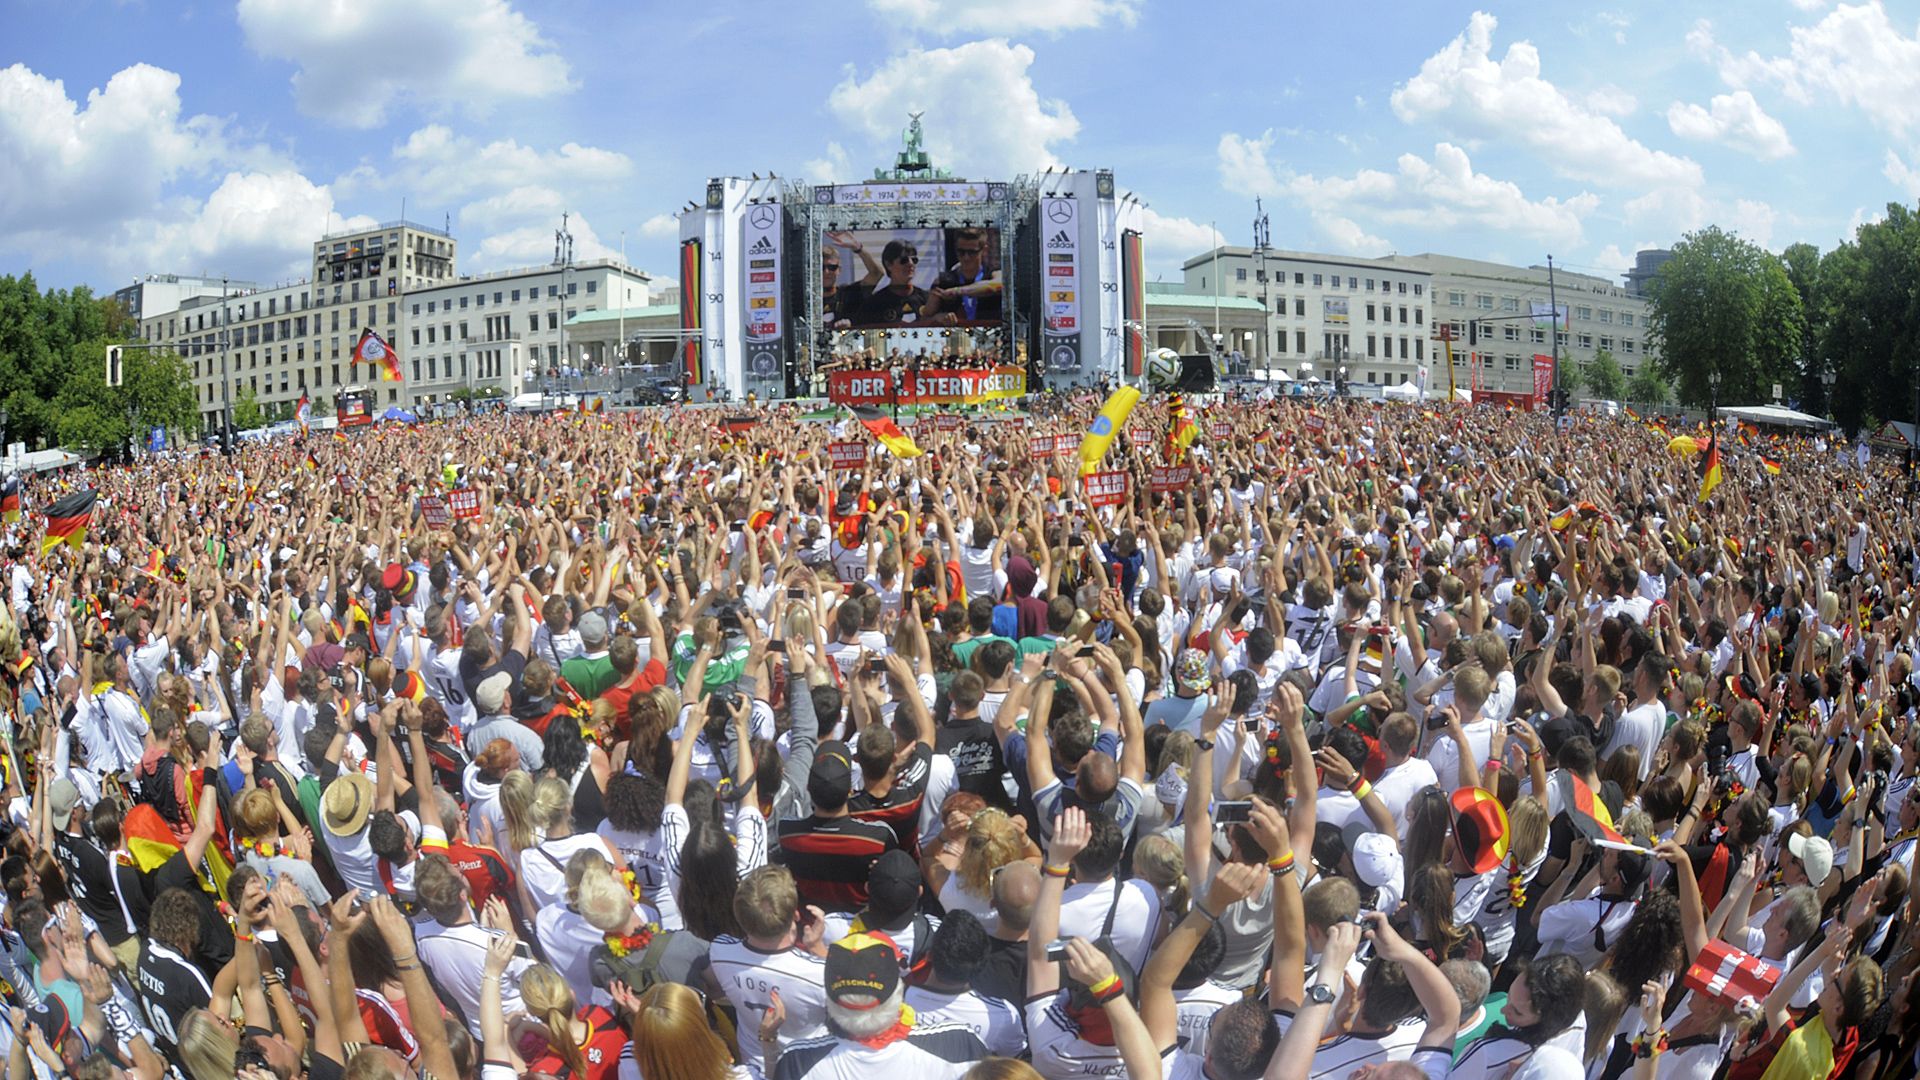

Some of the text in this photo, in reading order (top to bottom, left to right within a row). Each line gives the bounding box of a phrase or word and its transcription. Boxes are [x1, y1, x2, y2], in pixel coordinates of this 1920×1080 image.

[841, 192, 859, 200] 1954
[878, 191, 895, 199] 1974
[914, 190, 932, 199] 1990
[748, 246, 776, 255] adidas
[1047, 241, 1075, 249] adidas
[850, 377, 886, 397] DER
[915, 377, 973, 396] STERN
[846, 565, 865, 580] 10
[435, 677, 465, 706] 16
[139, 966, 165, 996] YETIS
